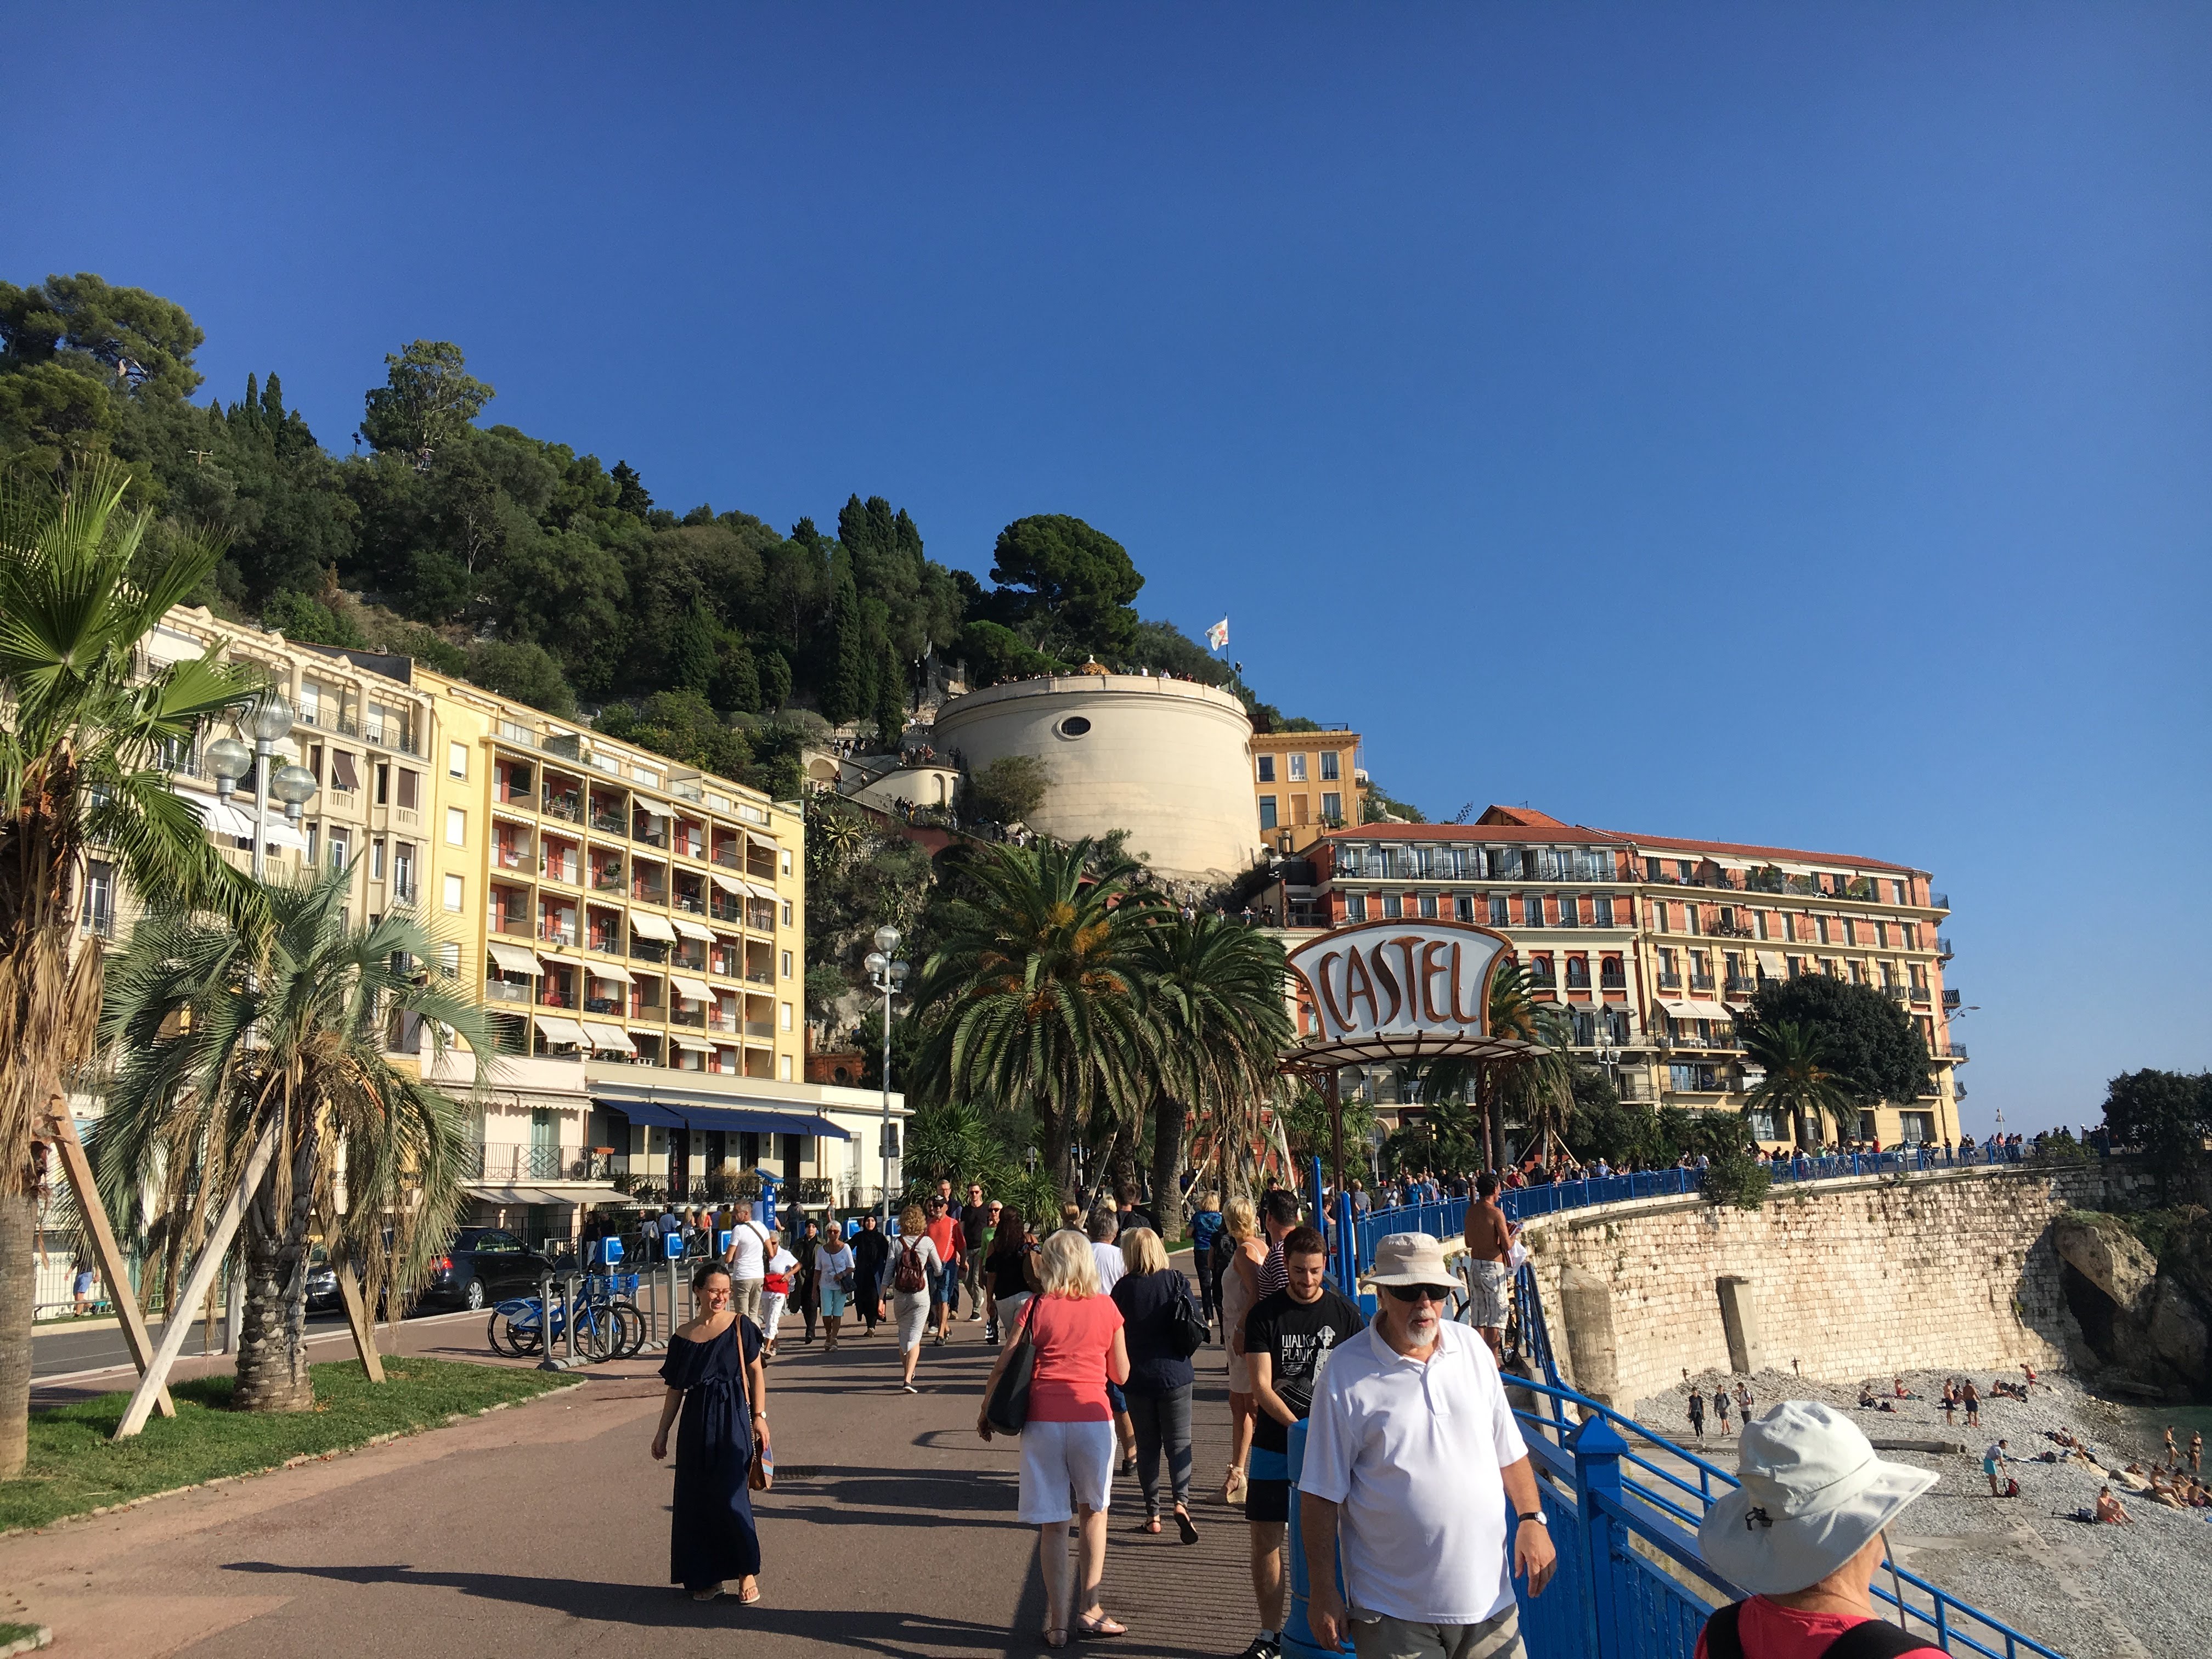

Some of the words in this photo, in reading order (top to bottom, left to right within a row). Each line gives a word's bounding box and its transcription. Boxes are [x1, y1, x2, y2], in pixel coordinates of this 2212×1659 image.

[1319, 936, 1478, 1032] CASTEL
[1282, 1334, 1310, 1348] WALK
[1282, 1349, 1314, 1362] PLANK
